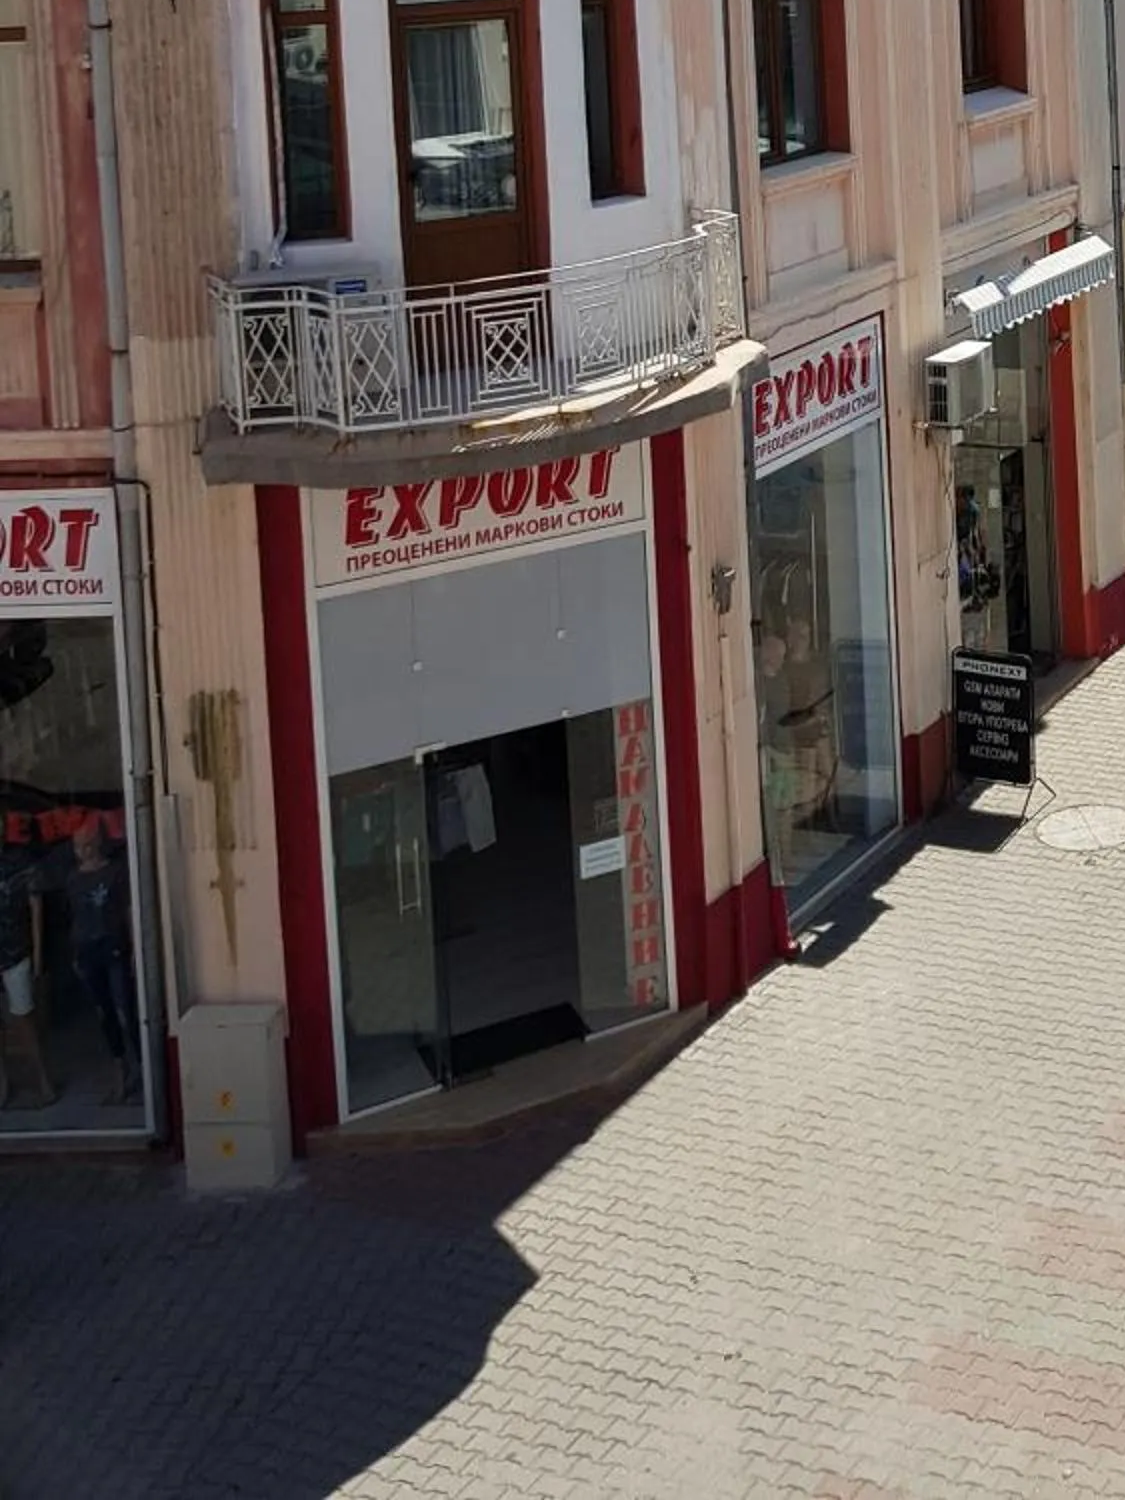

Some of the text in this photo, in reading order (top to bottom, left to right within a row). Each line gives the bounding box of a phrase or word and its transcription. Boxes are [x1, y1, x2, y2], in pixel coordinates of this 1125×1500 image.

[754, 336, 872, 438] EXPORT
[755, 422, 811, 462] ПРЕОЦЕНЕНИ
[345, 445, 621, 549] EXPORT
[0, 504, 100, 573] RT
[346, 501, 624, 573] ПРЕОЦЕНЕНИ МАРКОВИ СТОКИ
[42, 579, 104, 596] СТОКИ
